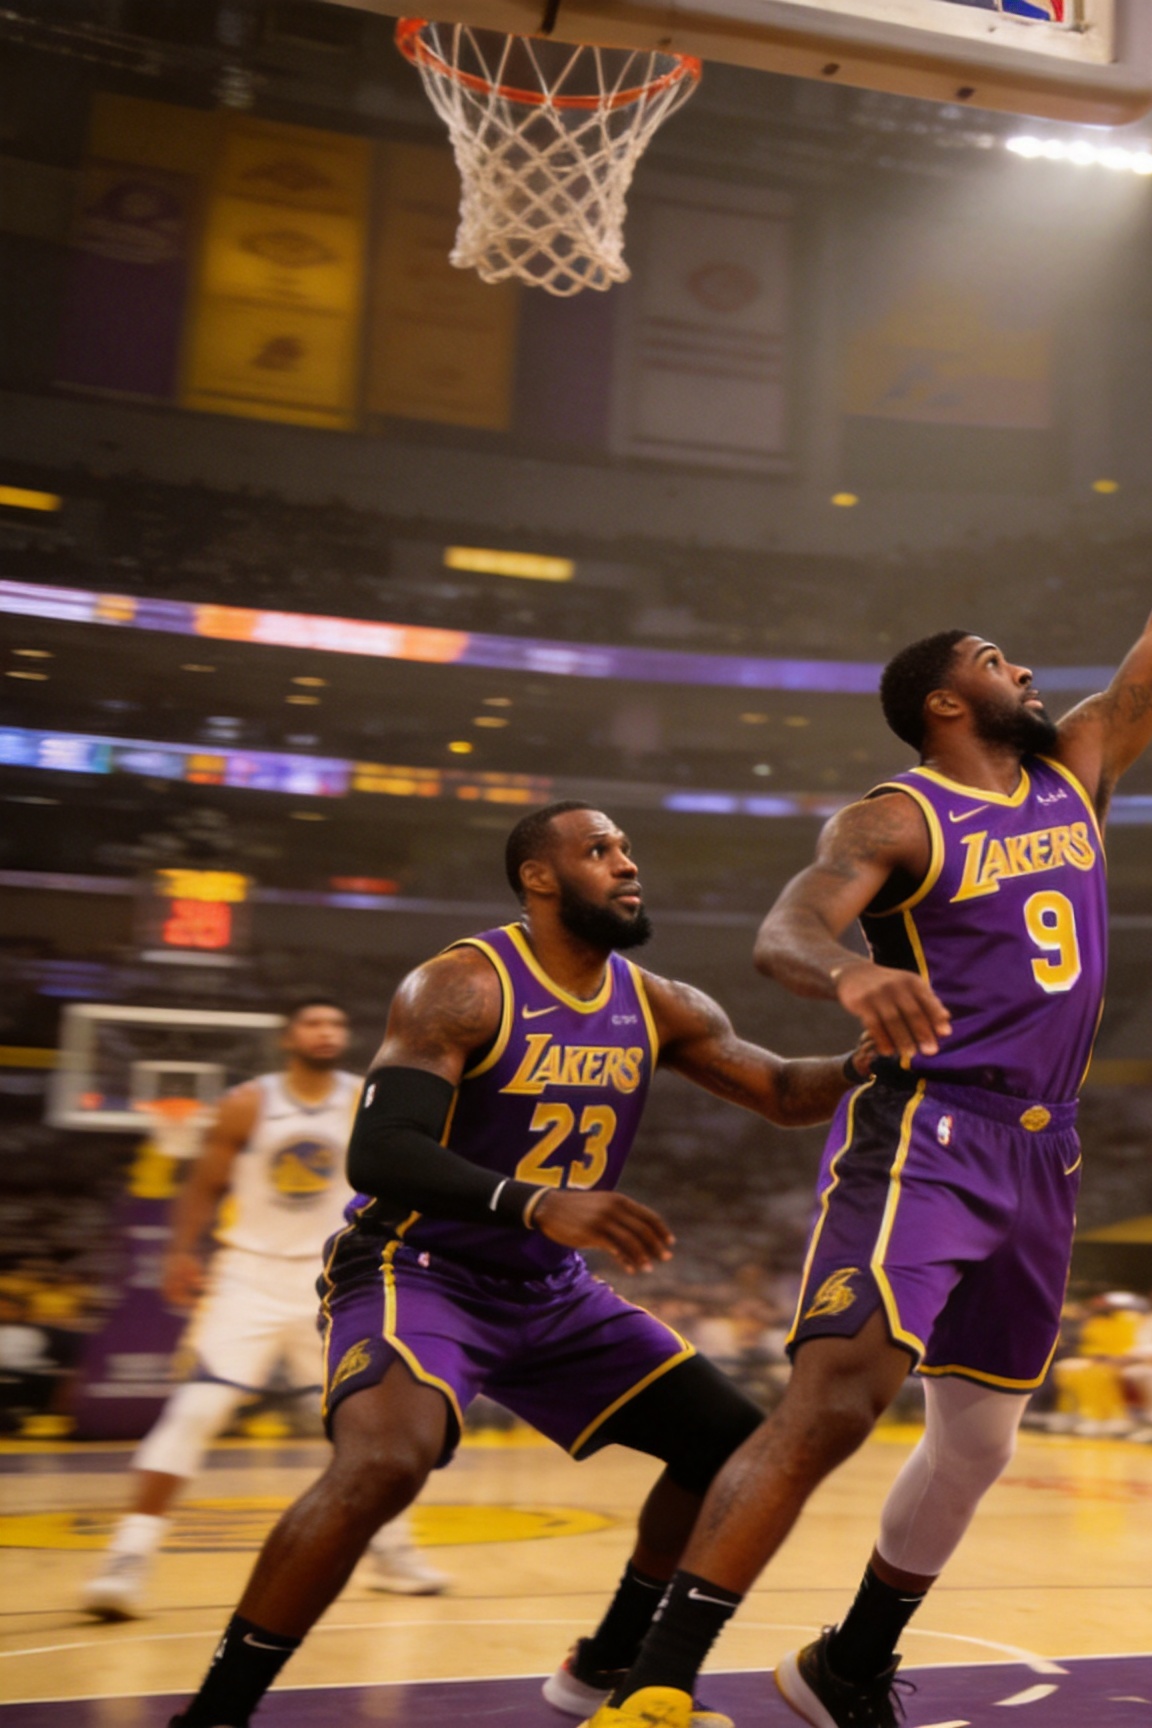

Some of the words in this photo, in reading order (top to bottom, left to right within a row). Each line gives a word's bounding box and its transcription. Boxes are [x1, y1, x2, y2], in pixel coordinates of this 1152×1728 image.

[949, 821, 1096, 903] LAKERS
[1023, 889, 1082, 994] 9
[497, 1032, 645, 1095] LAKERS
[513, 1101, 618, 1191] 23
